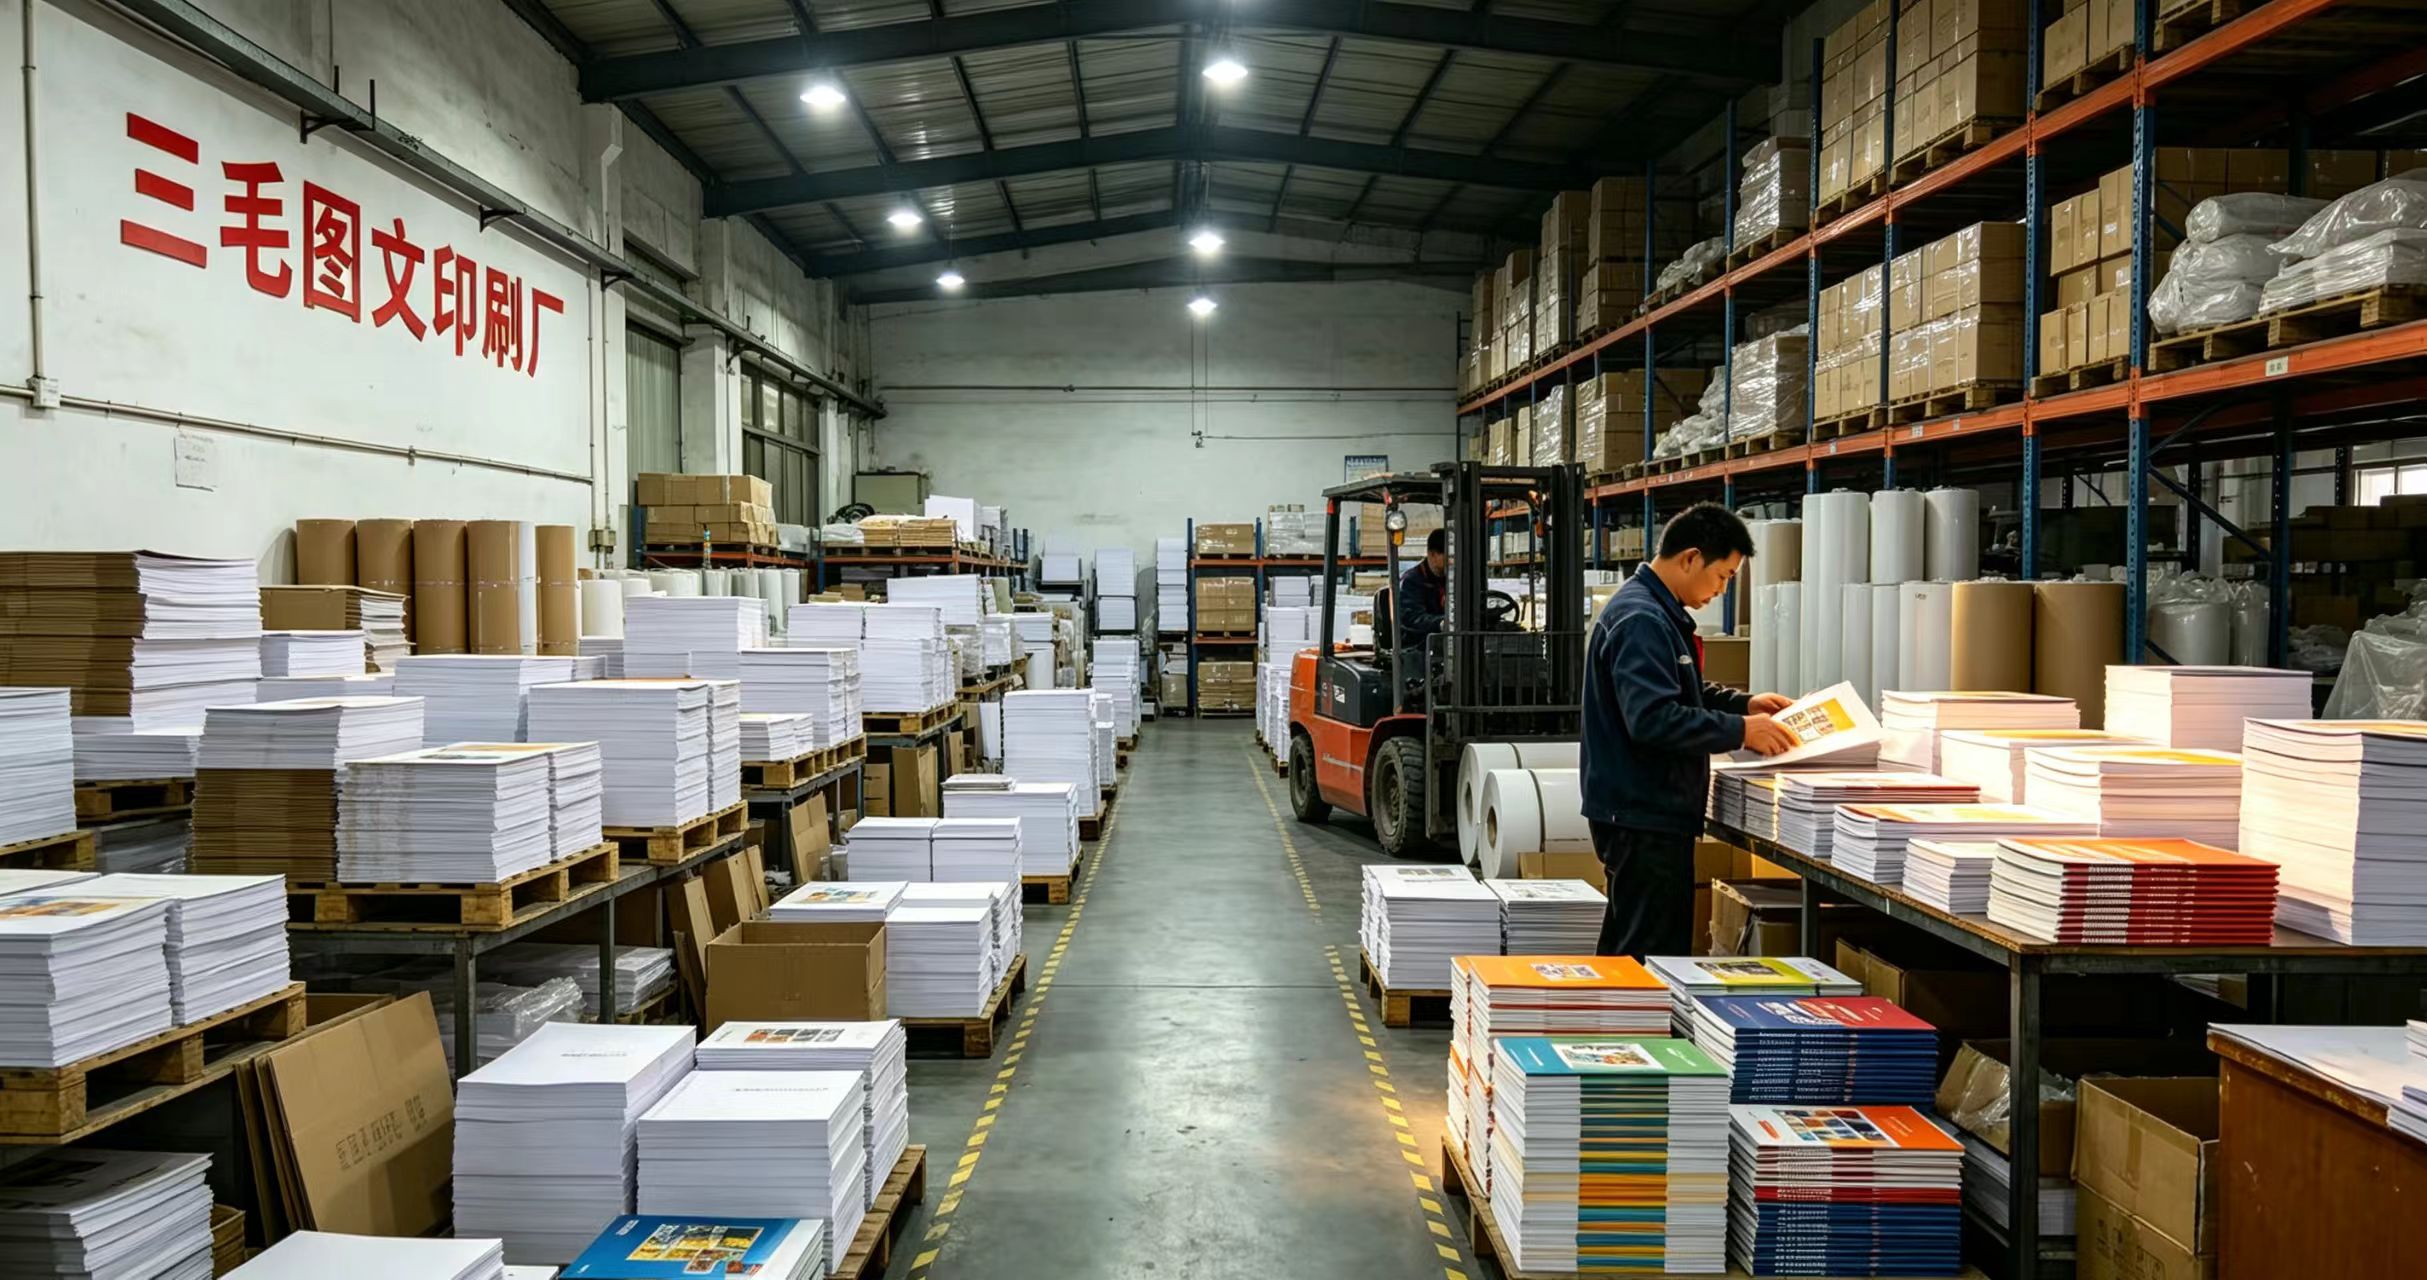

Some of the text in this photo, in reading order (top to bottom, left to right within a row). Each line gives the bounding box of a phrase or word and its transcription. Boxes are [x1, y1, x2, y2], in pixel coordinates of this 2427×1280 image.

[120, 112, 564, 377] 三毛图文印刷厂
